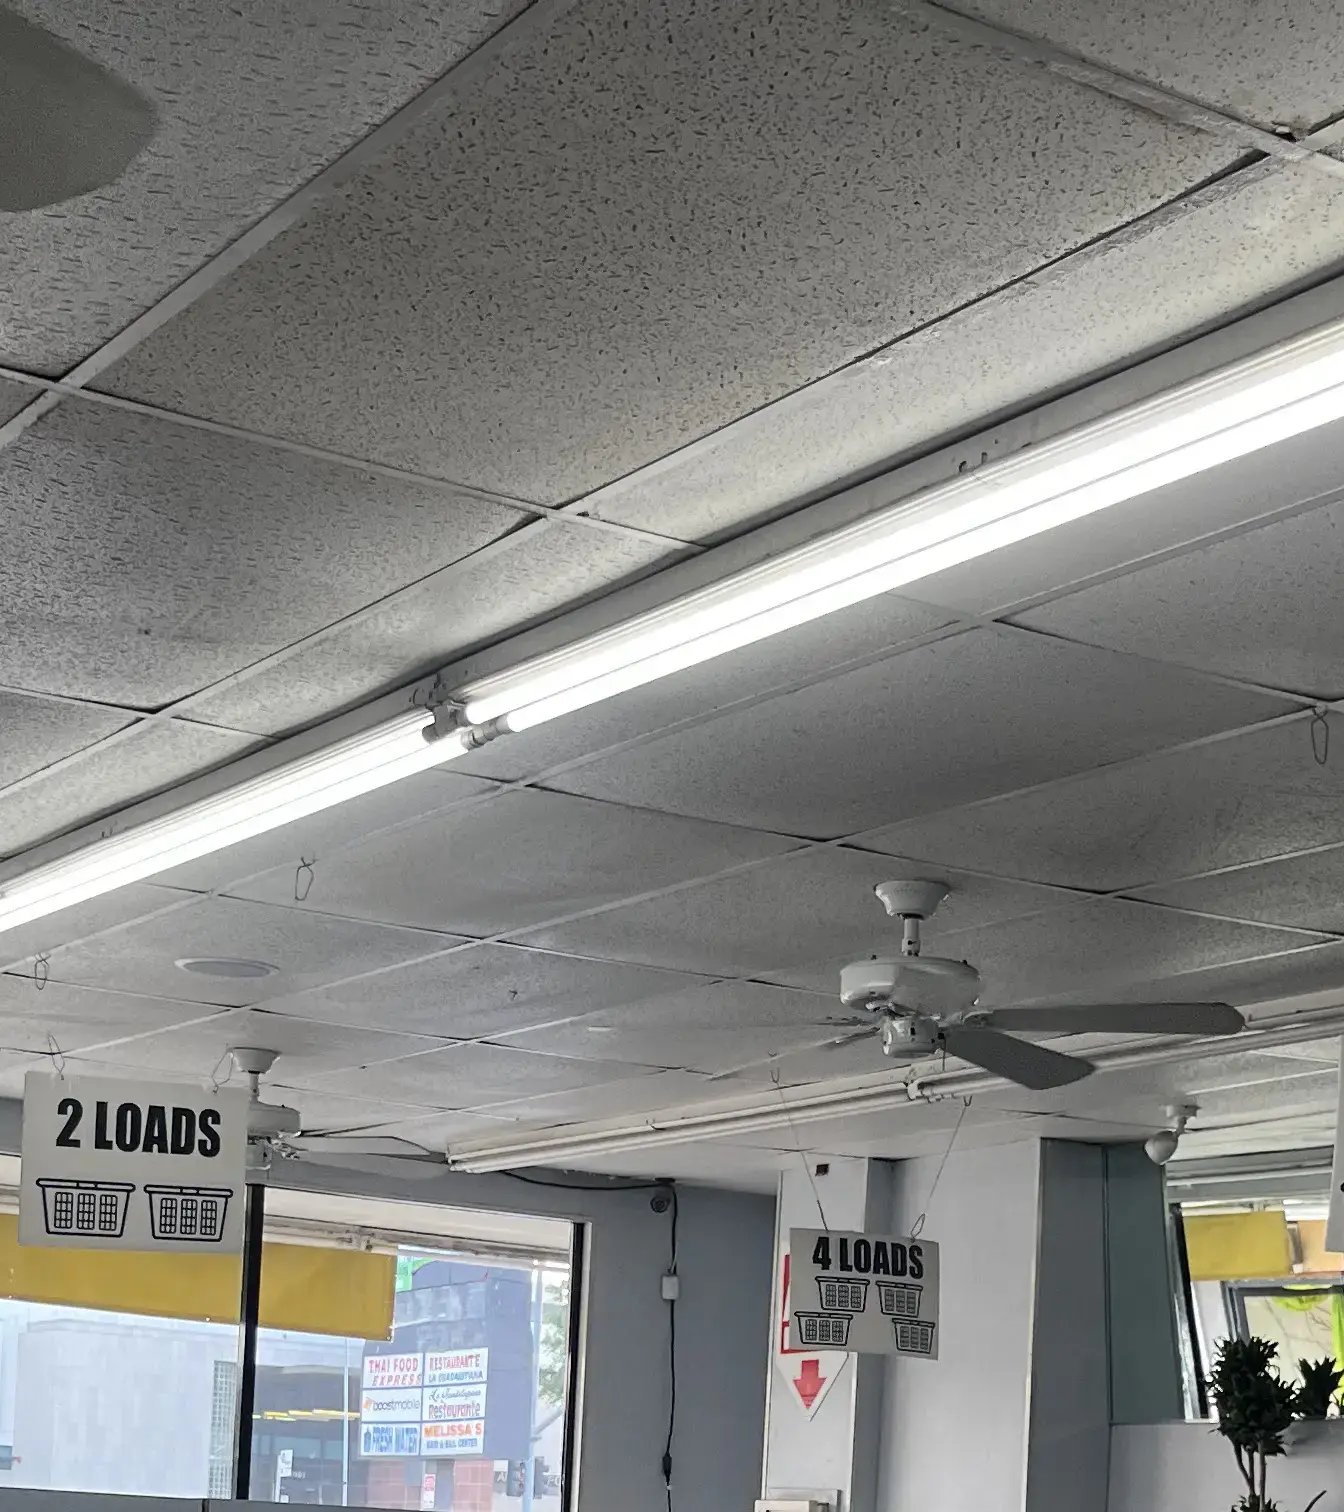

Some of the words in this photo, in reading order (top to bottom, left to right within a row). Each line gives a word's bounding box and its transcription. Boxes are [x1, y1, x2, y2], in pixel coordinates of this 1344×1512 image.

[56, 1098, 83, 1148] 2
[94, 1101, 221, 1158] LOADS
[812, 1236, 832, 1270] 4
[839, 1238, 924, 1280] LOADS
[369, 1360, 391, 1373] THAI
[394, 1358, 419, 1372] FOOD
[372, 1374, 422, 1387] EXPRESS
[424, 1423, 482, 1437] MELISSA'S
